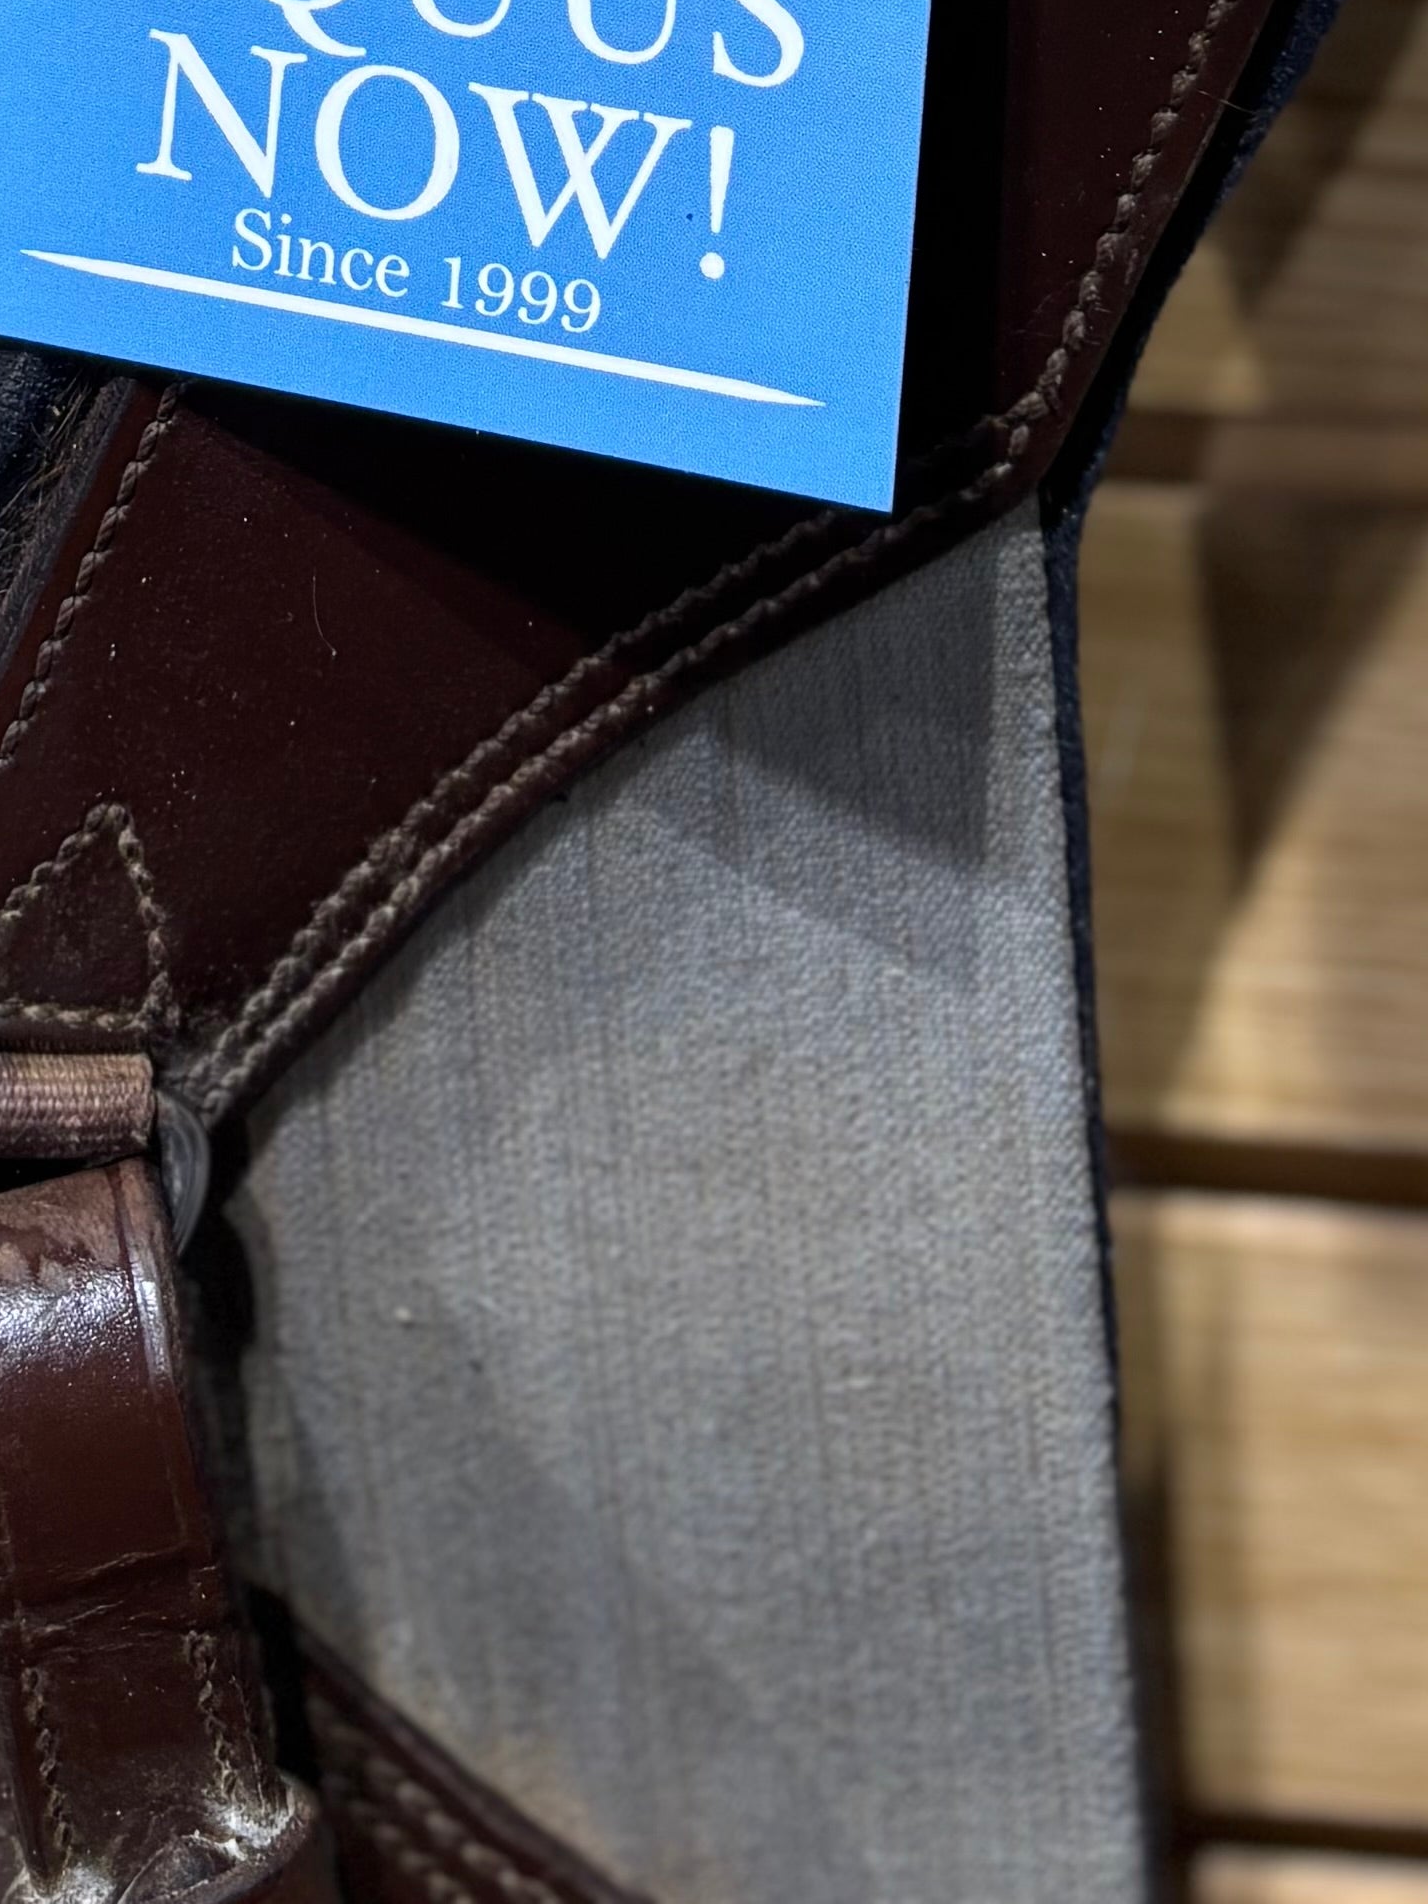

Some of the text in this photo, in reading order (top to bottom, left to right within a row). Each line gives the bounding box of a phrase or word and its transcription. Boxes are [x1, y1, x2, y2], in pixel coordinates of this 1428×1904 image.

[136, 28, 735, 281] NOW!
[231, 208, 602, 333] Since 1999
